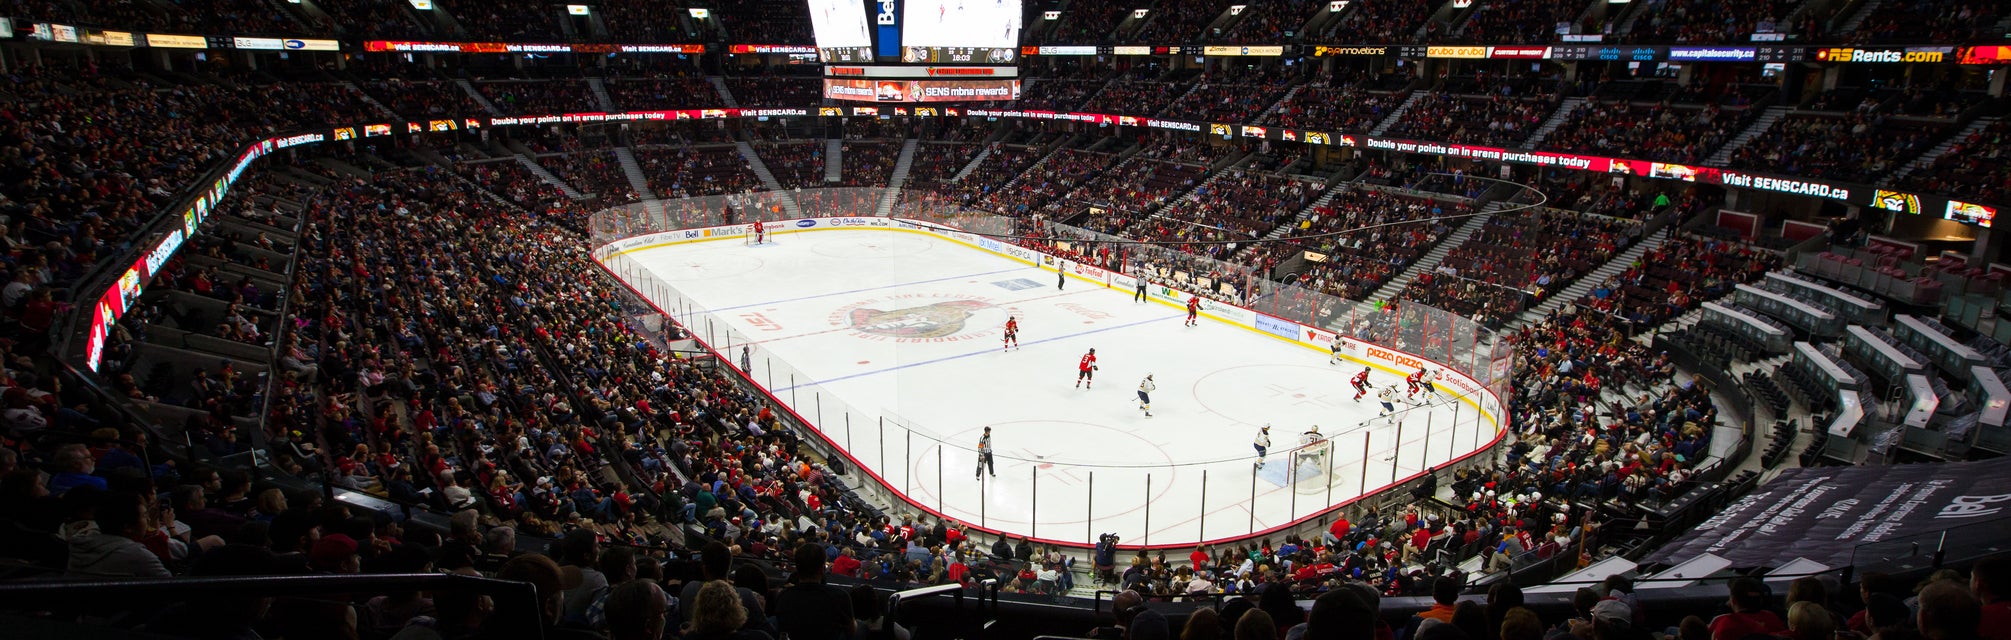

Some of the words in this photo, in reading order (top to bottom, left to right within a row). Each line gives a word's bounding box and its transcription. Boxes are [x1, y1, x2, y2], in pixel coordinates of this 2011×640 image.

[1429, 47, 1454, 56] aruba
[1458, 47, 1485, 56] aruba
[925, 87, 949, 96] SENS
[950, 86, 974, 96] mbna
[975, 86, 1008, 96] rewards
[491, 117, 518, 126] Double
[519, 116, 536, 125] your
[537, 115, 561, 124] points
[573, 114, 581, 122] in
[582, 114, 604, 122] arena
[605, 113, 643, 122] purchases
[644, 112, 665, 120] today
[1147, 119, 1160, 127] Visit
[1161, 120, 1200, 132] SENSCARD.ca
[1367, 138, 1395, 149] Double
[1397, 142, 1416, 151] your
[1418, 143, 1446, 154] points
[1448, 147, 1459, 156] on
[1461, 146, 1470, 156] in
[1472, 149, 1500, 159] arena
[1502, 150, 1556, 165] purchases
[1558, 155, 1591, 169] today
[1722, 172, 1751, 187] Visit
[1753, 176, 1849, 200] SENSCARD.ca
[685, 230, 699, 239] Bell
[711, 226, 743, 237] Mark's
[1366, 347, 1394, 362] pizza
[1395, 355, 1424, 370] pizza
